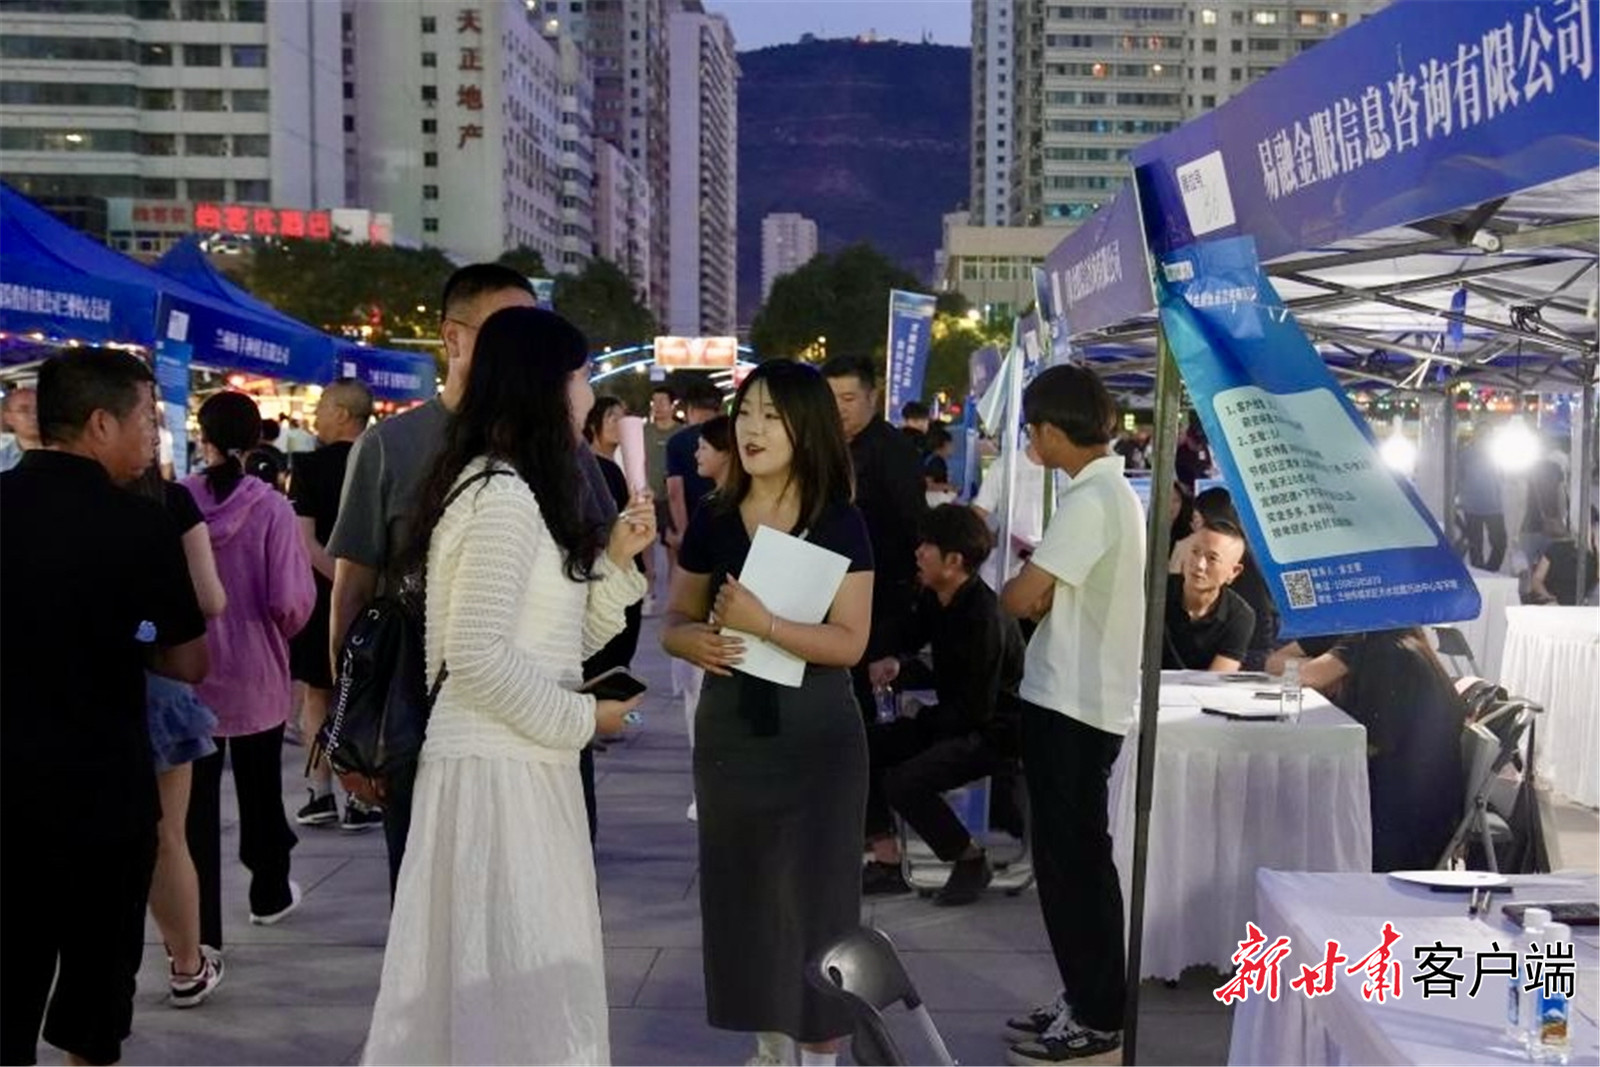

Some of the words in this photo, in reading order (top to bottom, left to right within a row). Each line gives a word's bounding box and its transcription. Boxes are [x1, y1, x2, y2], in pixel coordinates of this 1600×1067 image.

[457, 9, 484, 150] 天正地产
[1257, 0, 1592, 201] 易融金服信息咨询有限公司
